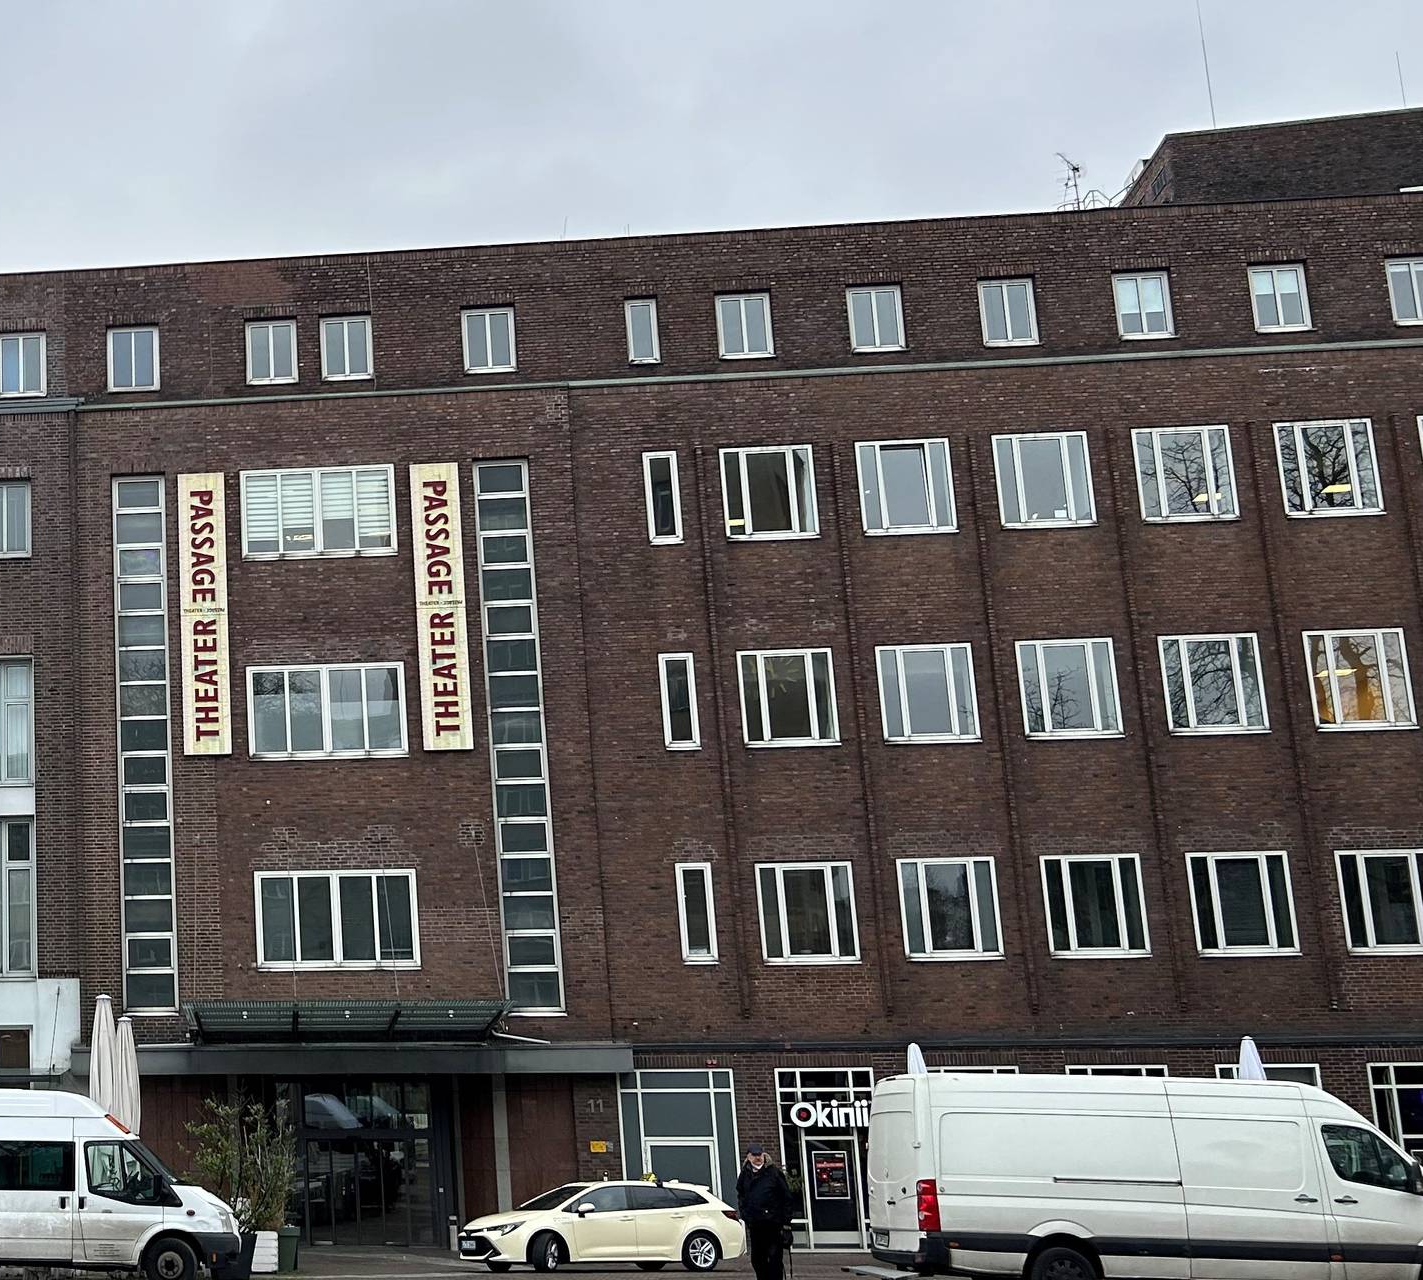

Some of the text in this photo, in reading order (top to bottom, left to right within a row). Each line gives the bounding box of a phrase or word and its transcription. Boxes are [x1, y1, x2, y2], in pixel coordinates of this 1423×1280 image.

[189, 490, 216, 603] PASSAGE
[422, 480, 453, 596] PASSAGE
[193, 618, 220, 742] THEATER
[429, 611, 461, 737] THEATER
[587, 1099, 604, 1113] 11
[790, 1099, 870, 1127] Okinii
